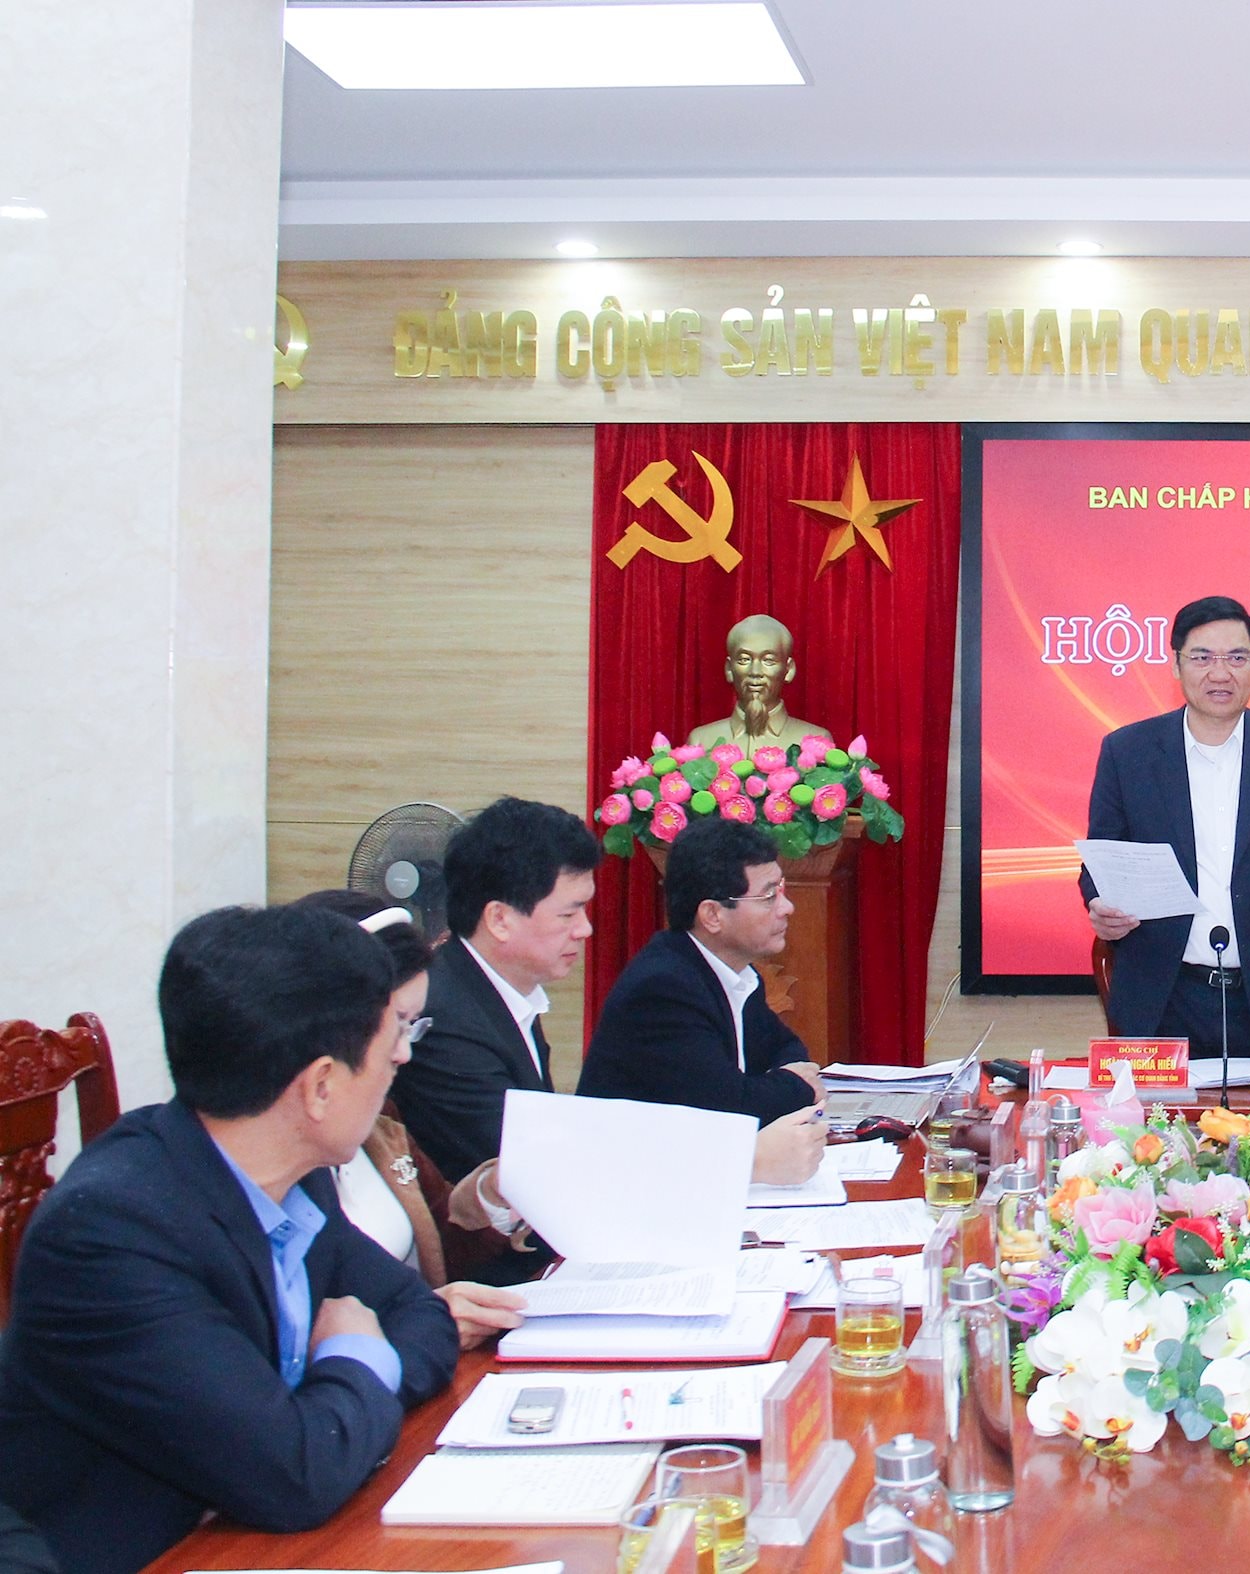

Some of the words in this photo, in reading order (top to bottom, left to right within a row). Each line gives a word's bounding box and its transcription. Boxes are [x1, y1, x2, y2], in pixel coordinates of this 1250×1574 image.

[393, 290, 539, 377] ĐẢNG
[557, 295, 702, 391] CỘNG
[719, 284, 834, 377] SẢN
[852, 293, 968, 390] VIỆT
[986, 308, 1120, 376] NAM
[1088, 486, 1148, 509] BAN
[1156, 482, 1236, 509] CHẤP
[1041, 603, 1169, 677] HỘI
